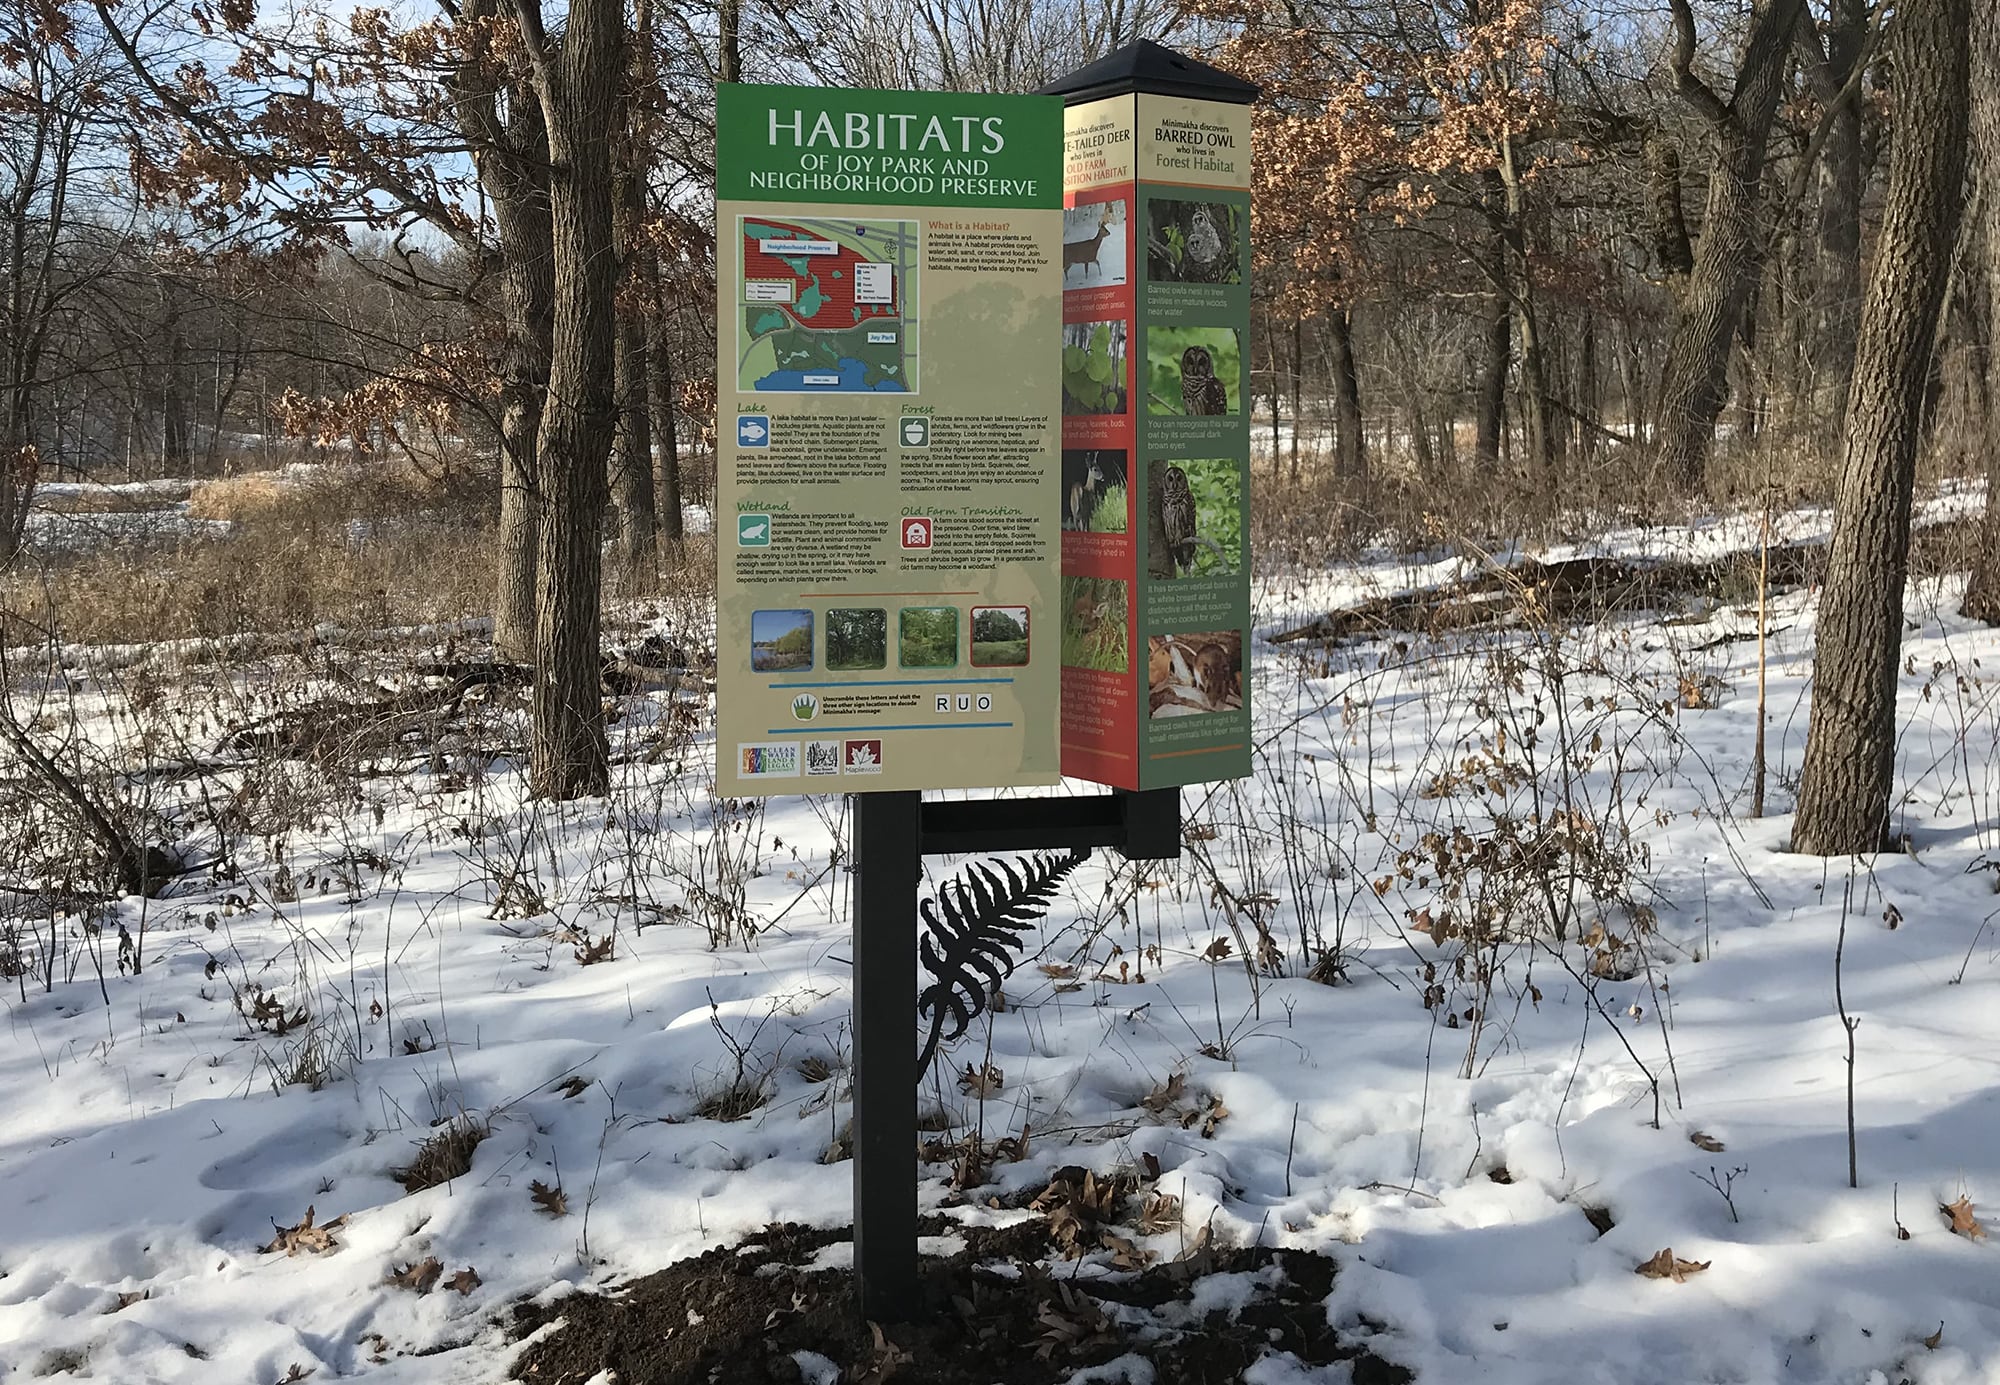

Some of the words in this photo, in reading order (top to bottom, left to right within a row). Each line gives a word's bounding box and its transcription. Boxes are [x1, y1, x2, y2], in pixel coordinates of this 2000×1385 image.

[769, 109, 1004, 154] HABITATS
[1089, 122, 1115, 133] discovers
[1162, 119, 1198, 129] Minimakha
[1200, 124, 1229, 133] discovers
[1108, 129, 1130, 144] DEER
[1155, 128, 1203, 144] BARRED
[1207, 134, 1235, 148] OWL
[1176, 146, 1190, 154] who
[1070, 152, 1082, 161] who
[1083, 151, 1095, 159] lives
[801, 154, 829, 170] OF
[836, 155, 874, 174] JOY
[882, 157, 934, 174] PARK
[941, 158, 989, 176] AND
[1067, 162, 1082, 174] OLD
[1085, 158, 1106, 172] FARM
[1156, 154, 1190, 169] Forest
[1194, 158, 1234, 172] Habitat
[1093, 166, 1128, 181] HABITAT
[750, 171, 934, 194] NEIGHBORHOOD
[941, 178, 1038, 196] PRESERVE
[929, 221, 952, 230] What
[956, 222, 962, 230] is
[973, 222, 1010, 231] Habitat?
[1148, 285, 1170, 294] Barred
[1172, 286, 1187, 294] owls
[1188, 287, 1202, 295] nest
[737, 403, 767, 413] Lake
[901, 404, 935, 414] Forest
[1148, 420, 1161, 428] You
[1176, 420, 1208, 429] recognize
[1222, 420, 1239, 429] large
[1161, 431, 1168, 440] by
[737, 501, 791, 512] Wetland
[900, 506, 923, 516] Old
[926, 506, 957, 516] Farm
[961, 505, 1023, 516] Transition
[937, 698, 948, 710] R
[958, 698, 968, 710] U
[978, 697, 990, 709] O
